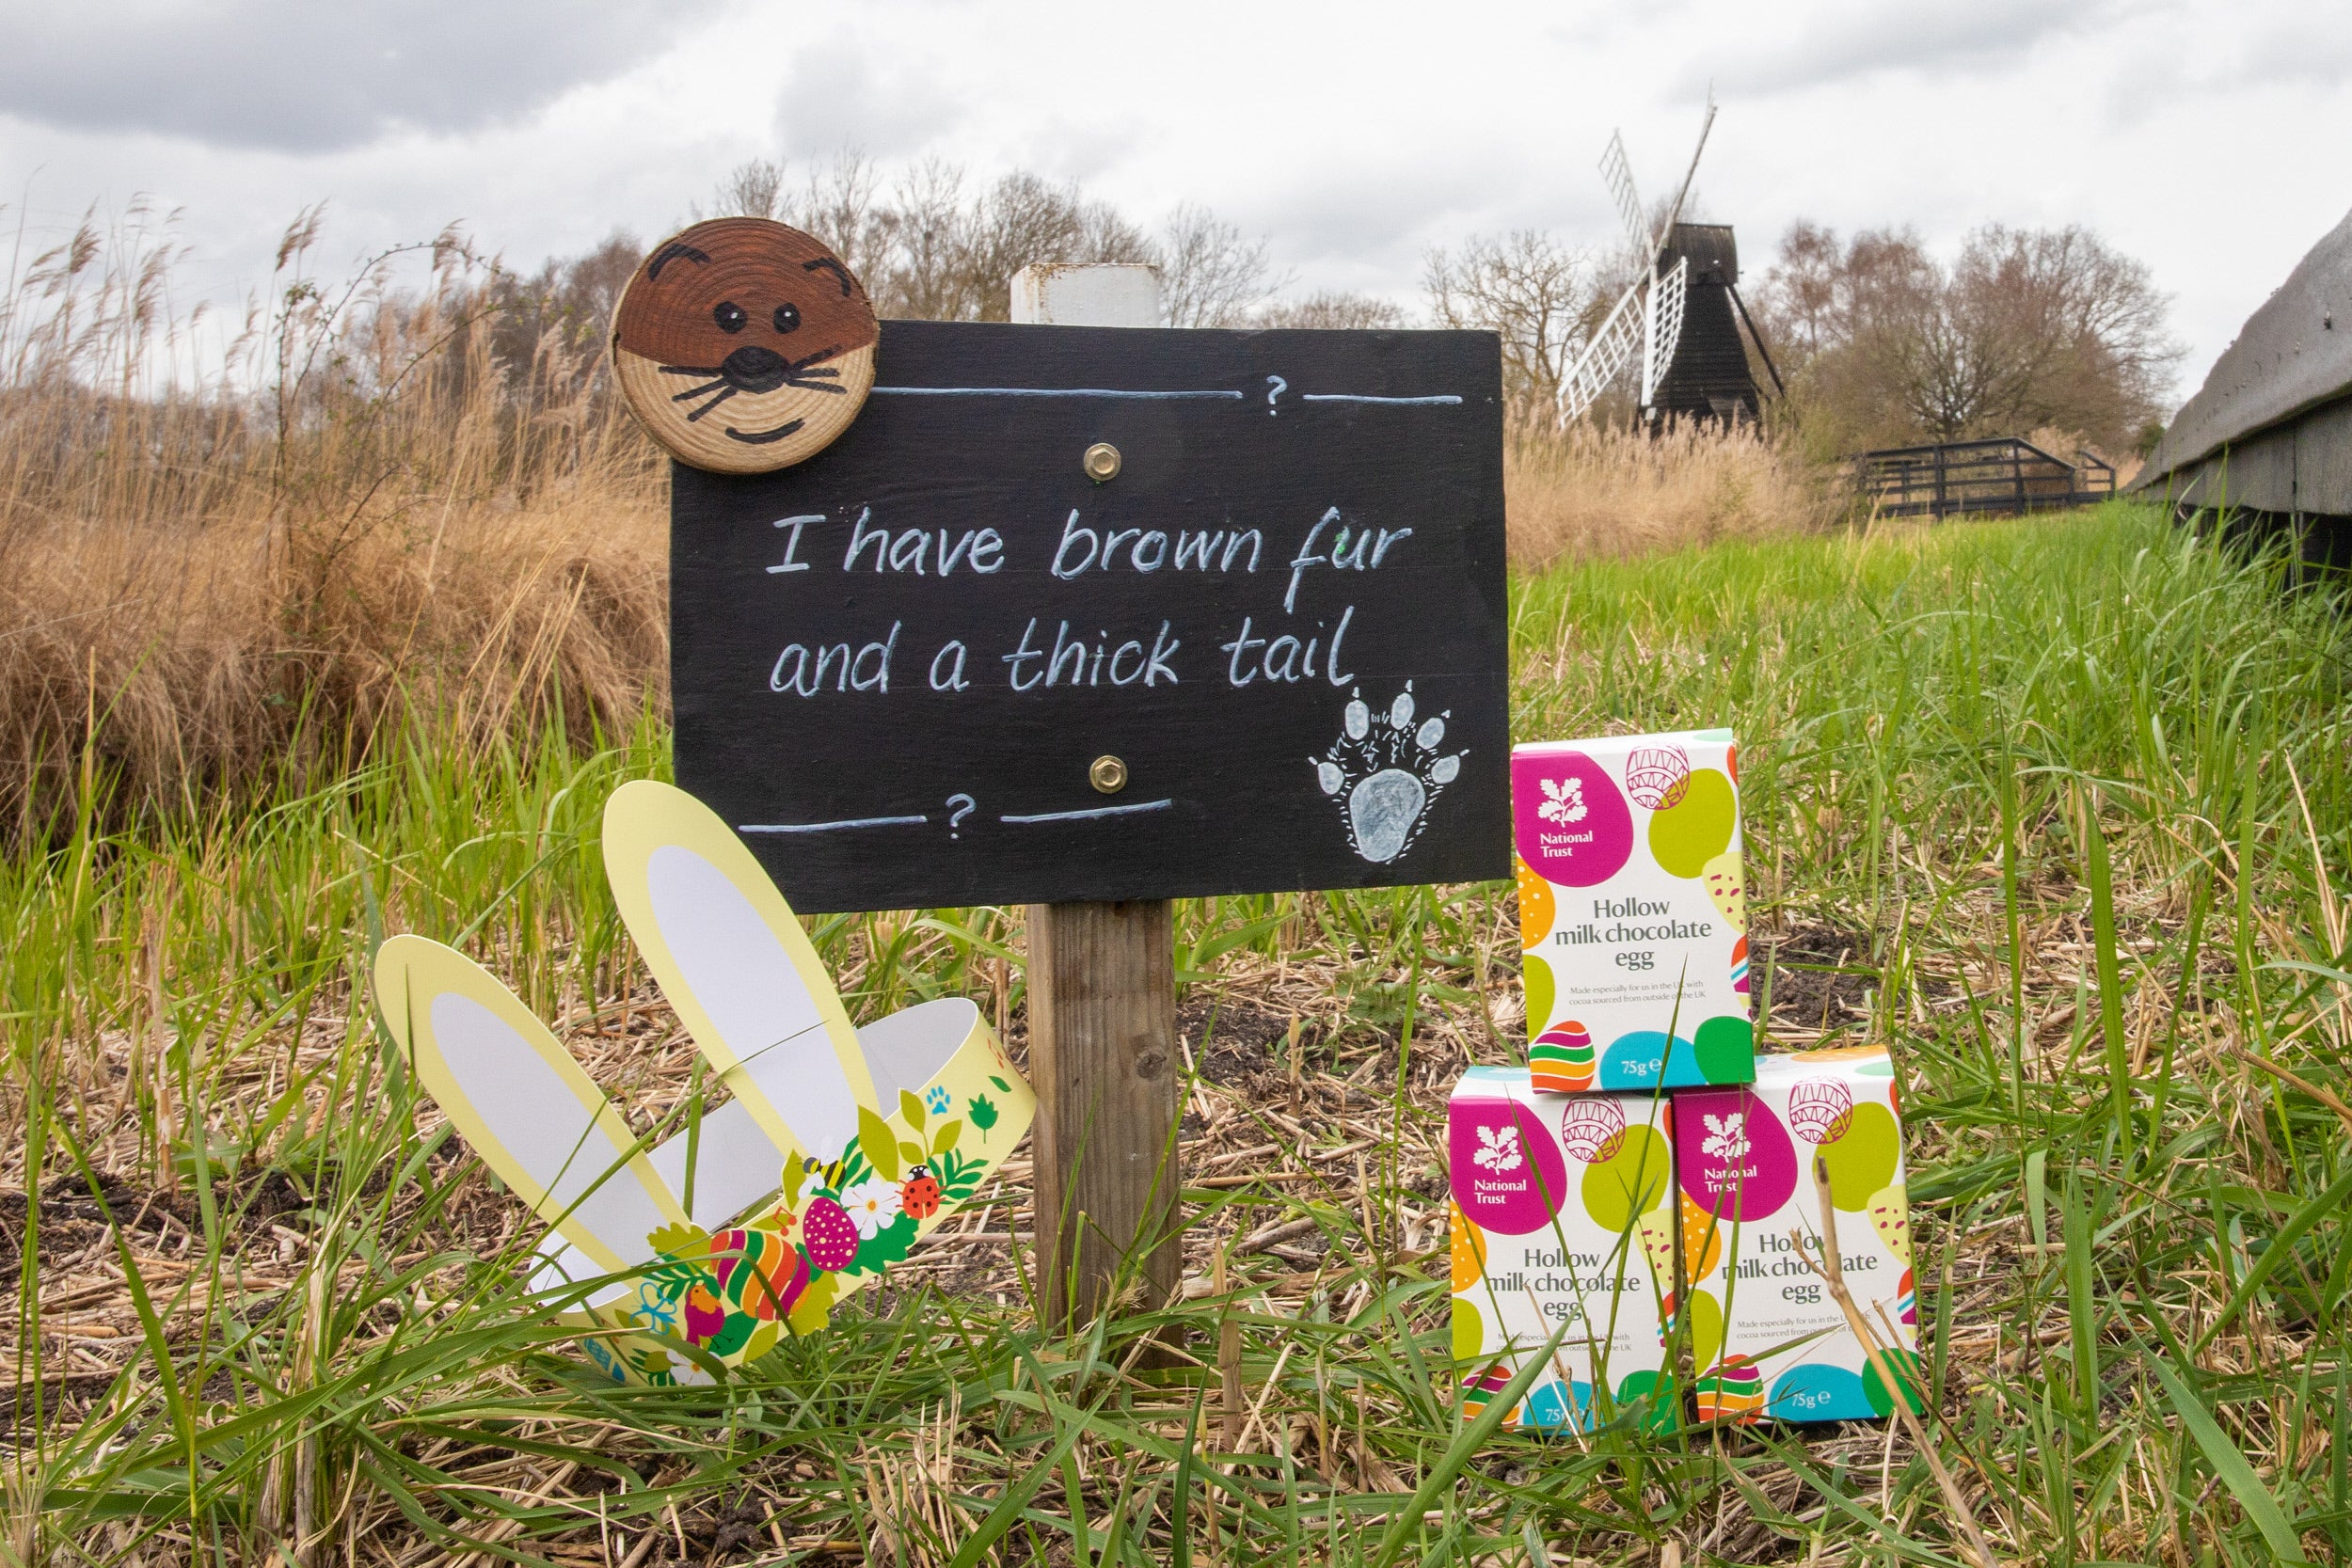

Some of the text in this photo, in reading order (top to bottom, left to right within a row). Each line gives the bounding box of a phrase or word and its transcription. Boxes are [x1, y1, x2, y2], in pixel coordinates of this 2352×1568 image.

[766, 505, 1414, 613] I have brown fur
[769, 605, 1356, 698] and a thick tail
[1539, 830, 1593, 846] National
[1539, 846, 1573, 858] Trust
[1594, 896, 1670, 919] Hollow
[1555, 919, 1711, 945] milk chocolate
[1615, 950, 1655, 971] egg
[1593, 984, 1627, 993] especially
[1673, 981, 1685, 990] U
[1593, 996, 1622, 1005] sourced
[1623, 994, 1642, 1003] from
[1643, 992, 1670, 1001] outside
[1474, 1179, 1527, 1192] National
[1474, 1192, 1506, 1204] Trust
[1772, 1253, 1878, 1276] choclate
[1782, 1284, 1821, 1305] egg
[1543, 1301, 1581, 1322] egg
[1759, 1318, 1795, 1328] especially
[1613, 1332, 1630, 1340] with
[1760, 1329, 1789, 1338] sourced
[1790, 1327, 1809, 1337] from
